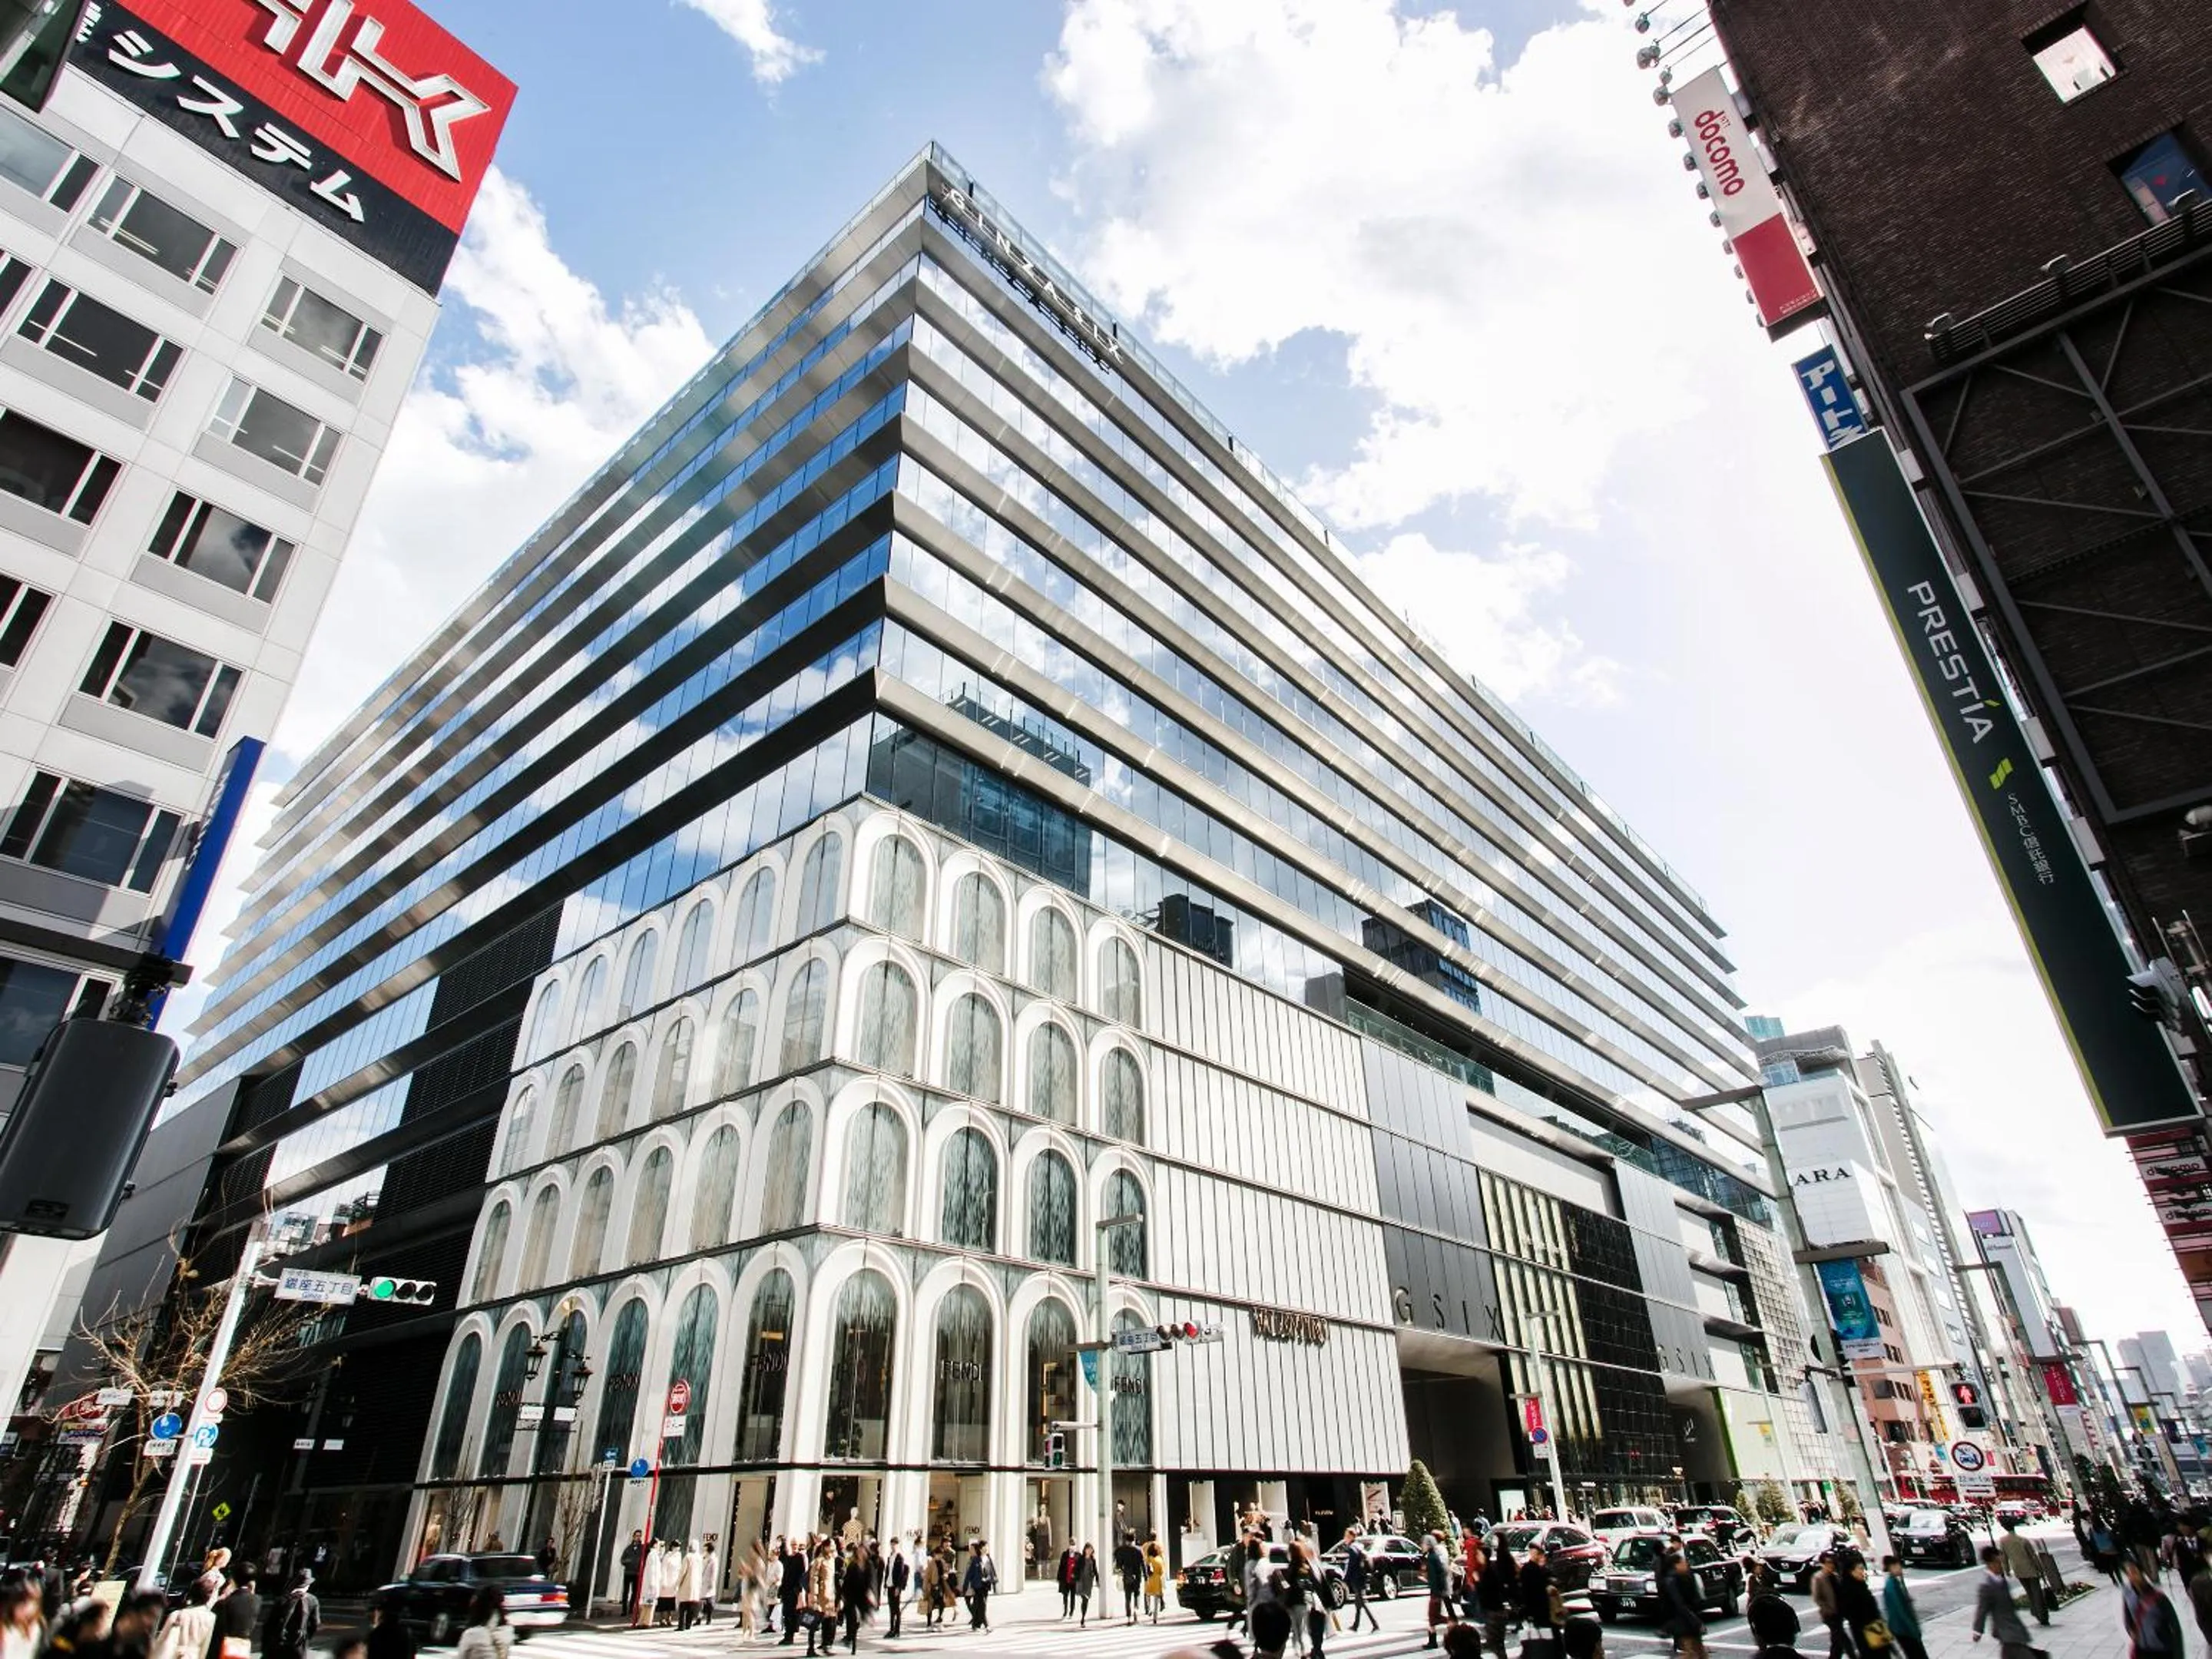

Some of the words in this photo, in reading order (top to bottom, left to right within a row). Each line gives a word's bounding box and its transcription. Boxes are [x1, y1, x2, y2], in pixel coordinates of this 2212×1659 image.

[1694, 110, 1745, 196] docomo
[949, 189, 1058, 299] GINZA
[1075, 306, 1124, 365] SIX
[1794, 1167, 1853, 1186] ARA
[284, 1277, 353, 1296] 銀座五丁目
[940, 1359, 983, 1382] FENDI
